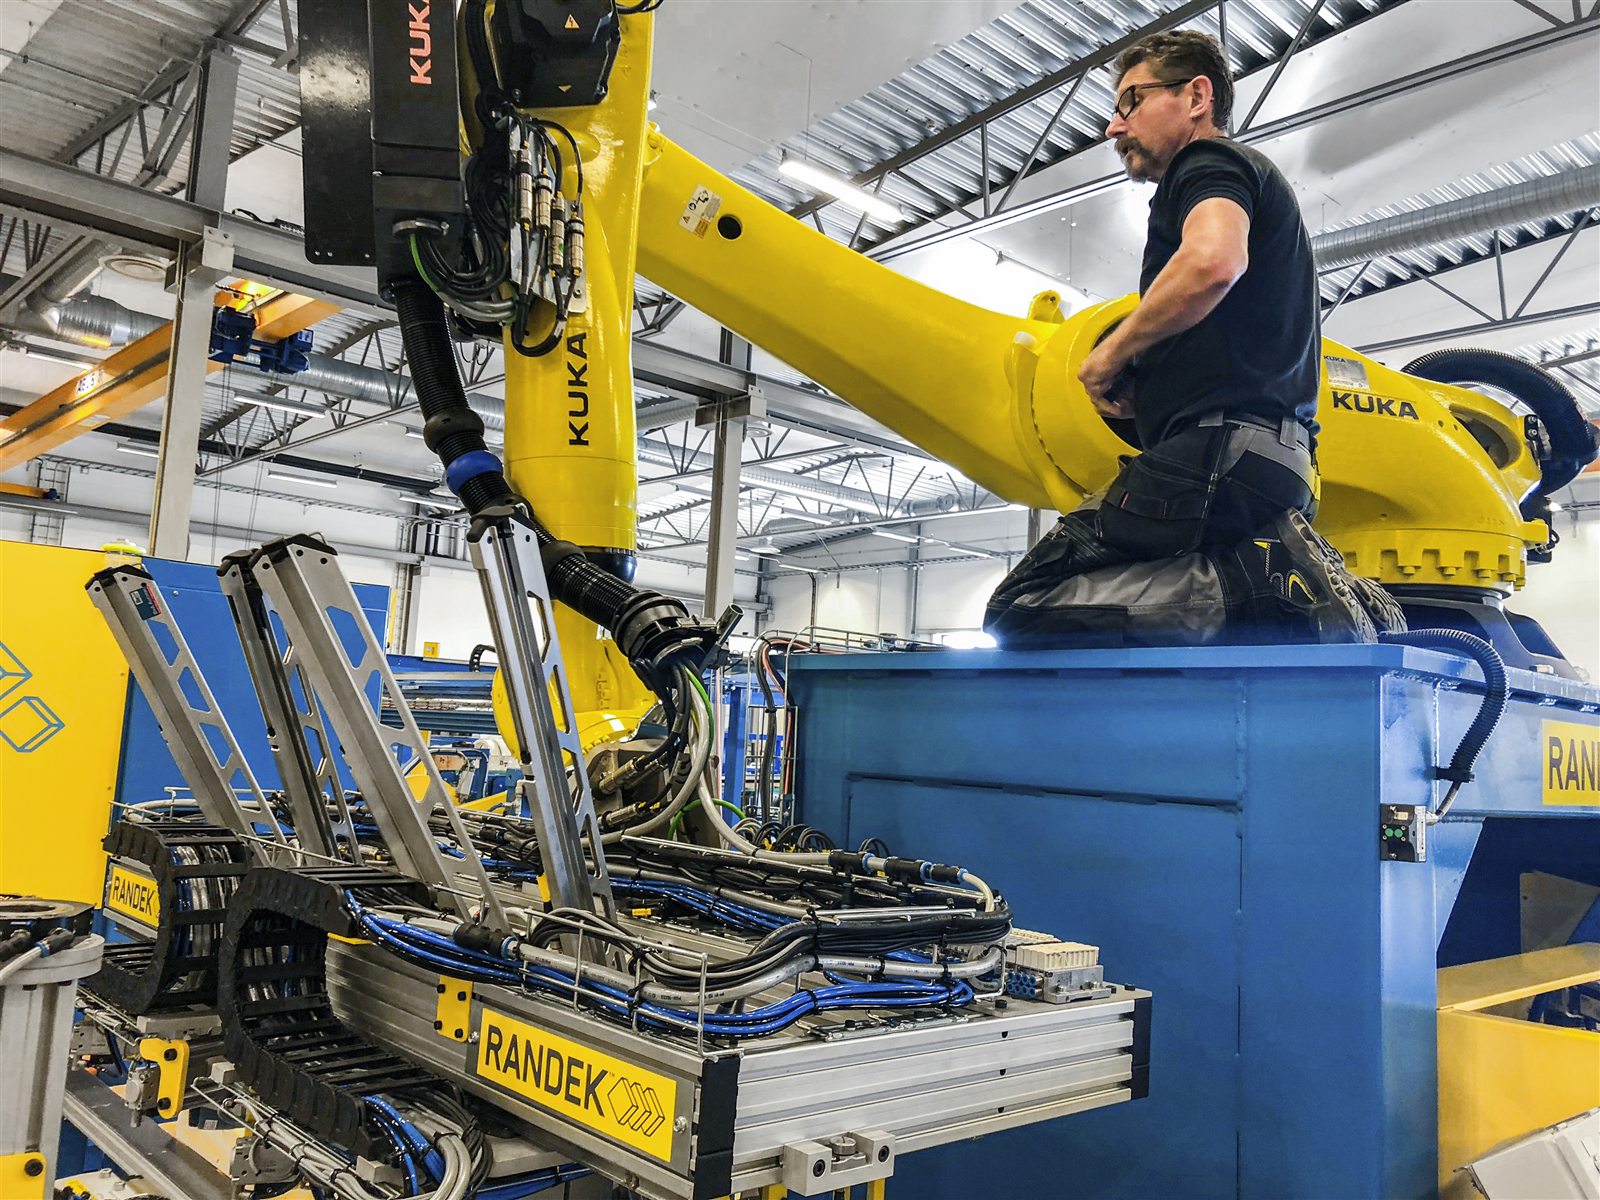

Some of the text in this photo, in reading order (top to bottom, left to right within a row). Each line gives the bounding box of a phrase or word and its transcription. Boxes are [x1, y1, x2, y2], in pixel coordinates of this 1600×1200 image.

[408, 0, 432, 85] KUK
[1323, 355, 1346, 363] KUKA
[567, 332, 589, 446] KUKA
[1332, 391, 1419, 420] KUKA
[1549, 735, 1600, 791] RAN
[112, 876, 155, 916] RANDEK
[485, 1024, 608, 1118] RANDEK
